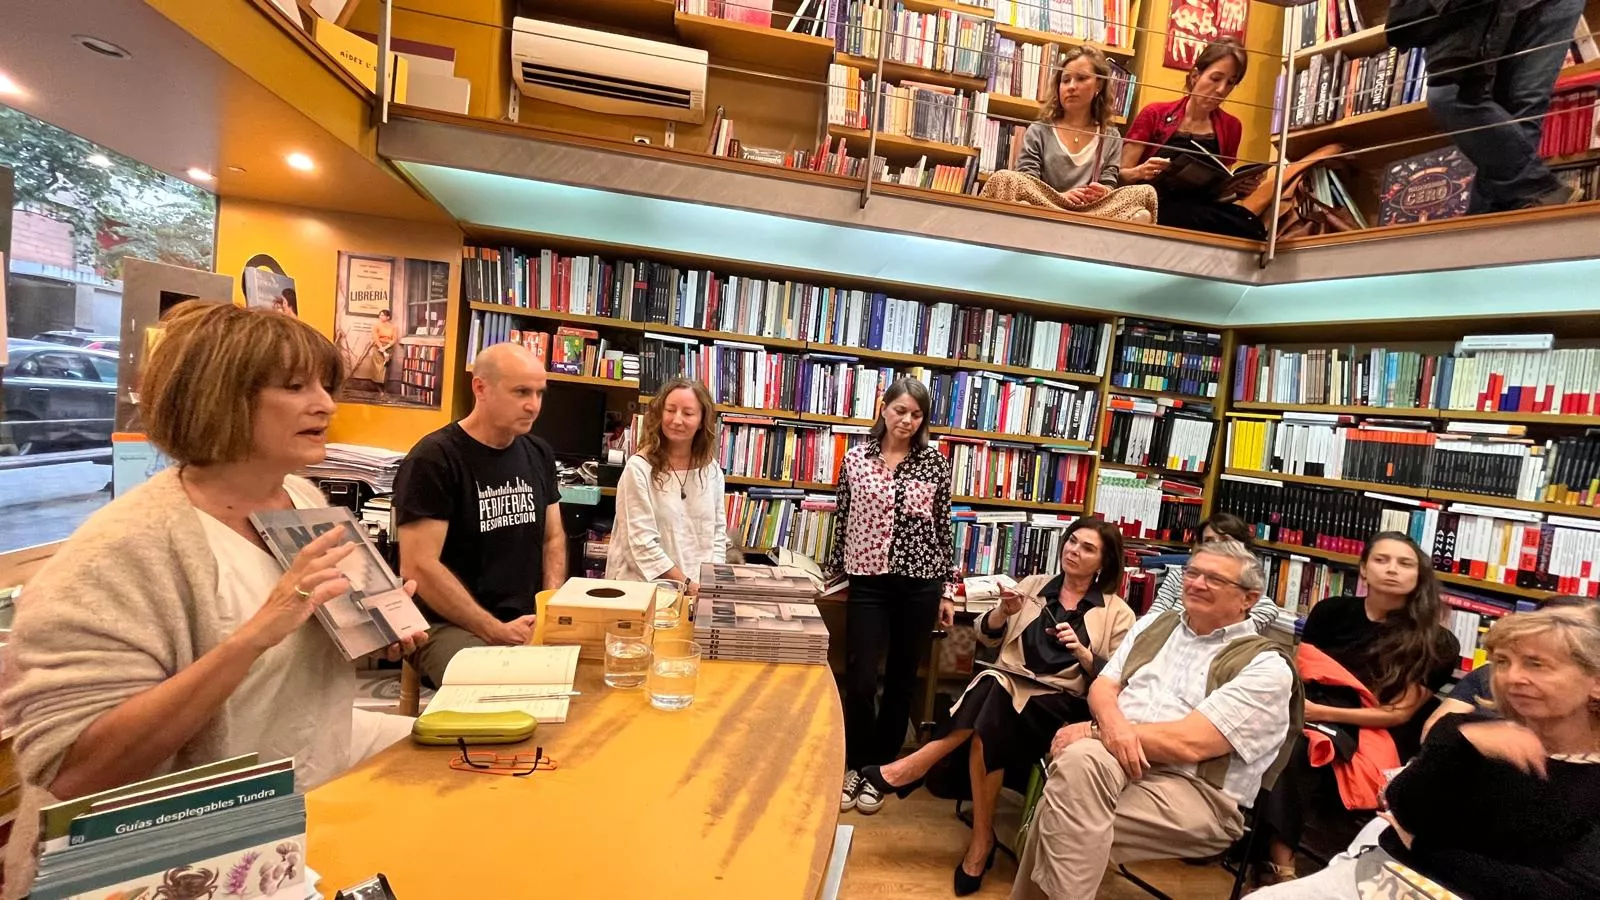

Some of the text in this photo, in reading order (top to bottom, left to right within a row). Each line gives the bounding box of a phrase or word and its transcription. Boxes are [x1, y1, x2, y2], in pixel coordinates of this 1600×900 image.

[350, 288, 388, 302] LIBRERÍA
[115, 787, 276, 835] Guías desplegables Tundra
